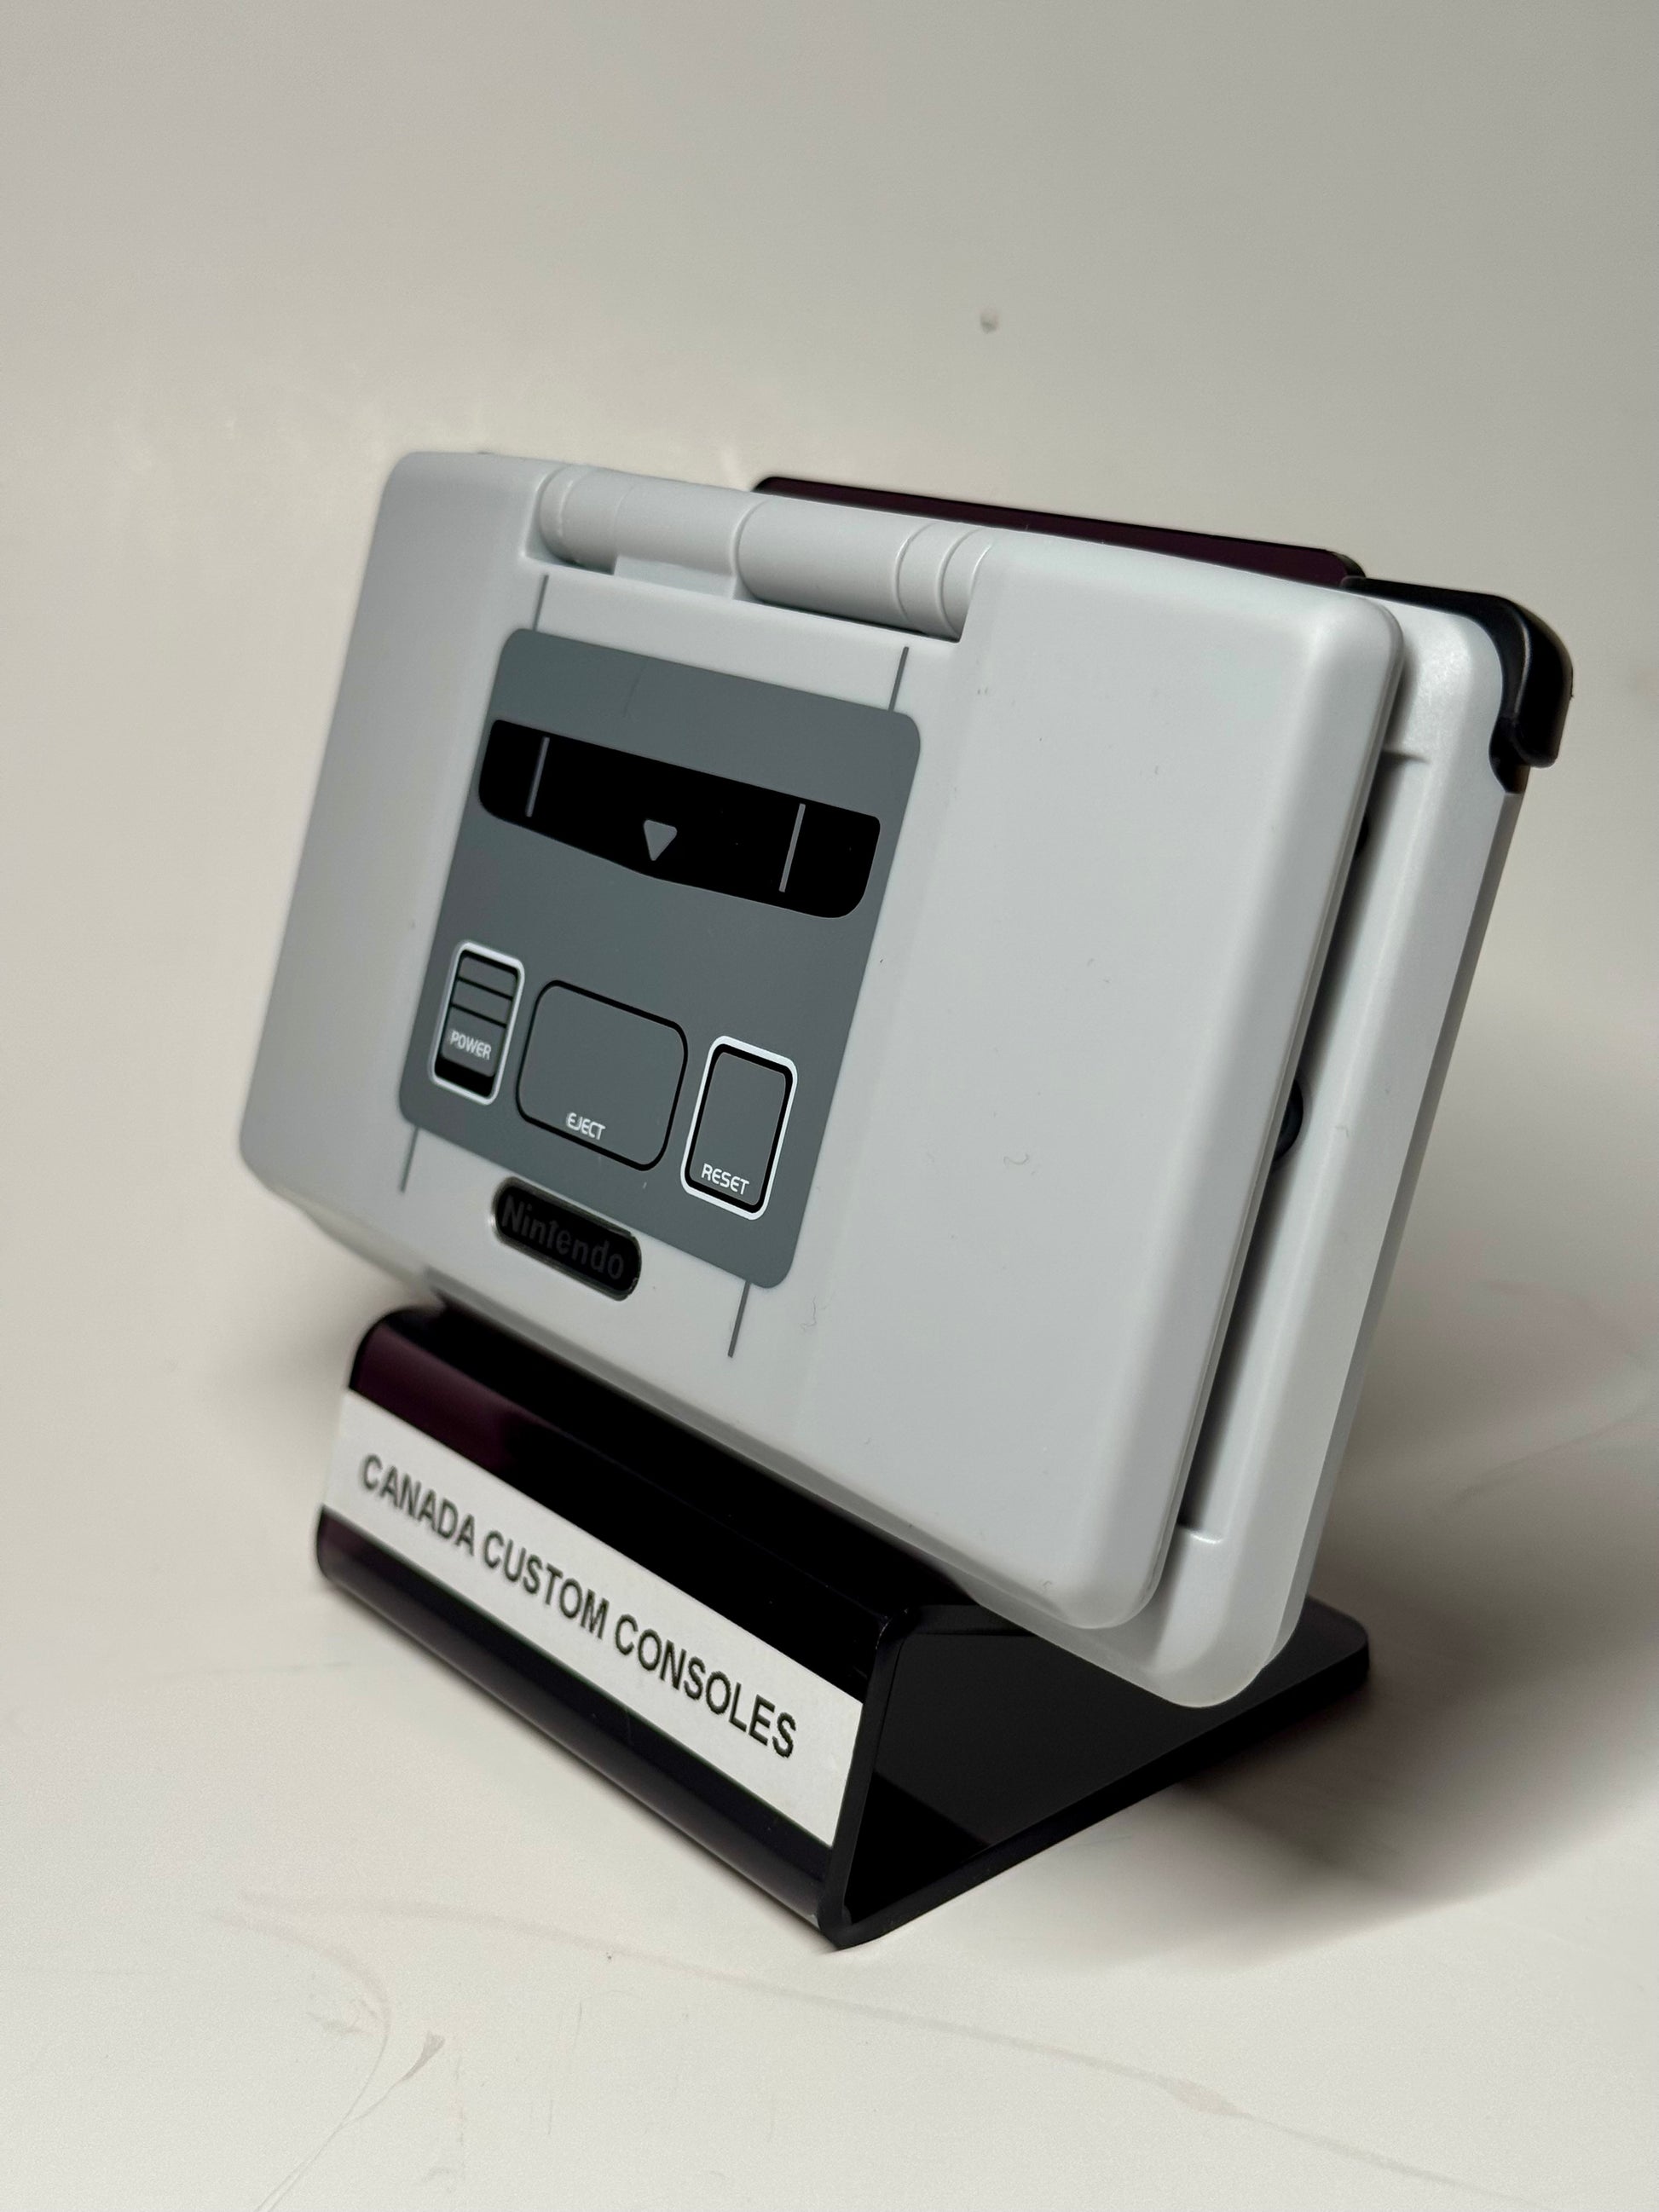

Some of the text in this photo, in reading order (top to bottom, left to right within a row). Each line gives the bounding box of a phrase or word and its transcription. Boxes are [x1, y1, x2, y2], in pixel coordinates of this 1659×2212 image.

[450, 1030, 492, 1060] POWER
[566, 1112, 606, 1140] EJECT
[701, 1164, 749, 1195] RESET
[501, 1194, 624, 1279] Nintendo
[361, 1454, 796, 1758] CANADA CUSTOM CONSOLES
